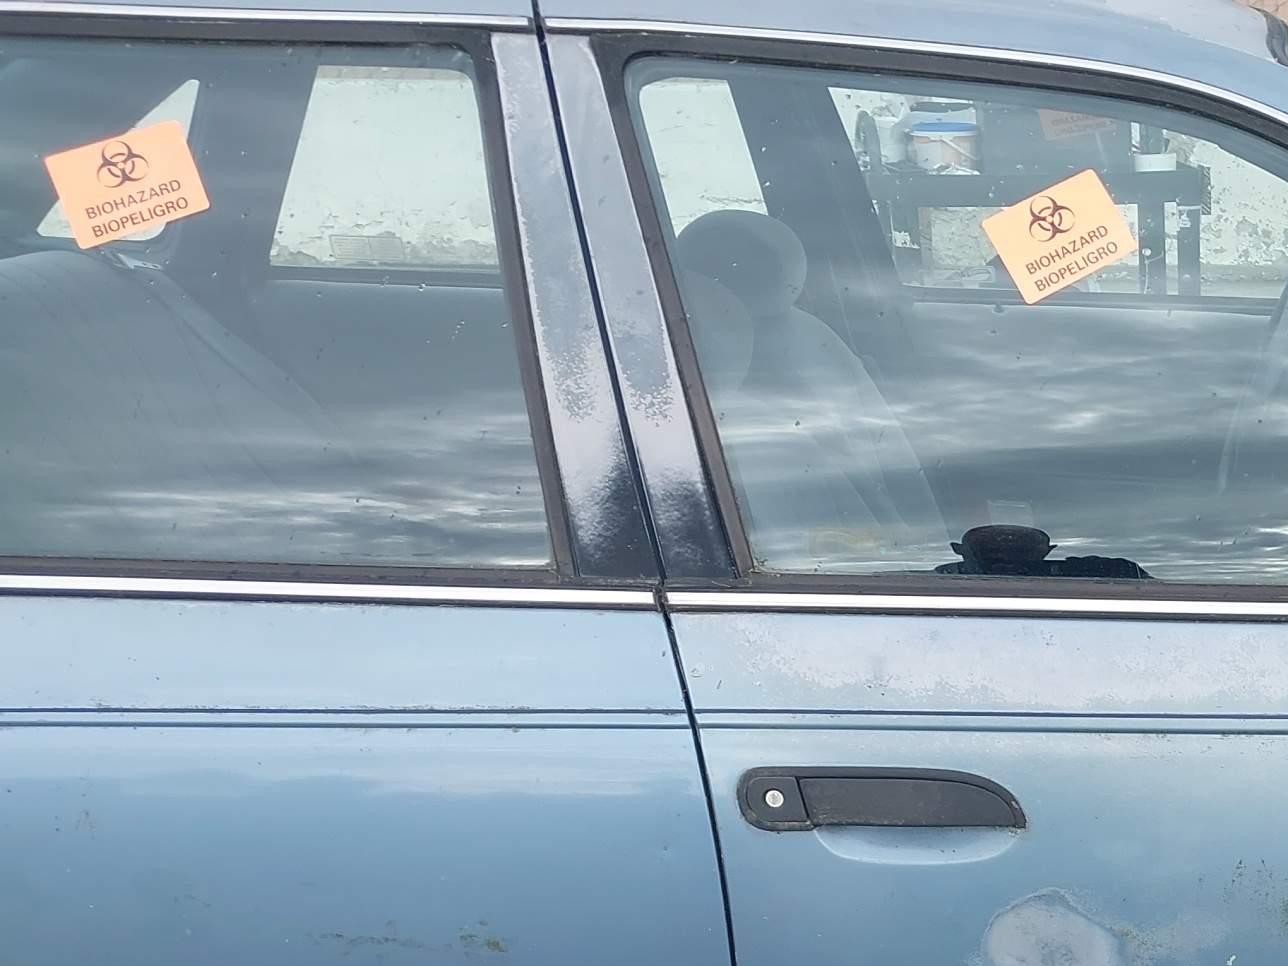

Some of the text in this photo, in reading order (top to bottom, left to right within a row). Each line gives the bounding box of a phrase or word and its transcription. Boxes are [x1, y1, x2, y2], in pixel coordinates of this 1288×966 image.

[85, 179, 182, 220] BIOHAZARD
[91, 196, 189, 238] BIOPELIGRO
[1025, 225, 1109, 275] BIOHAZARD
[1034, 241, 1118, 292] BIOPELIGRO
